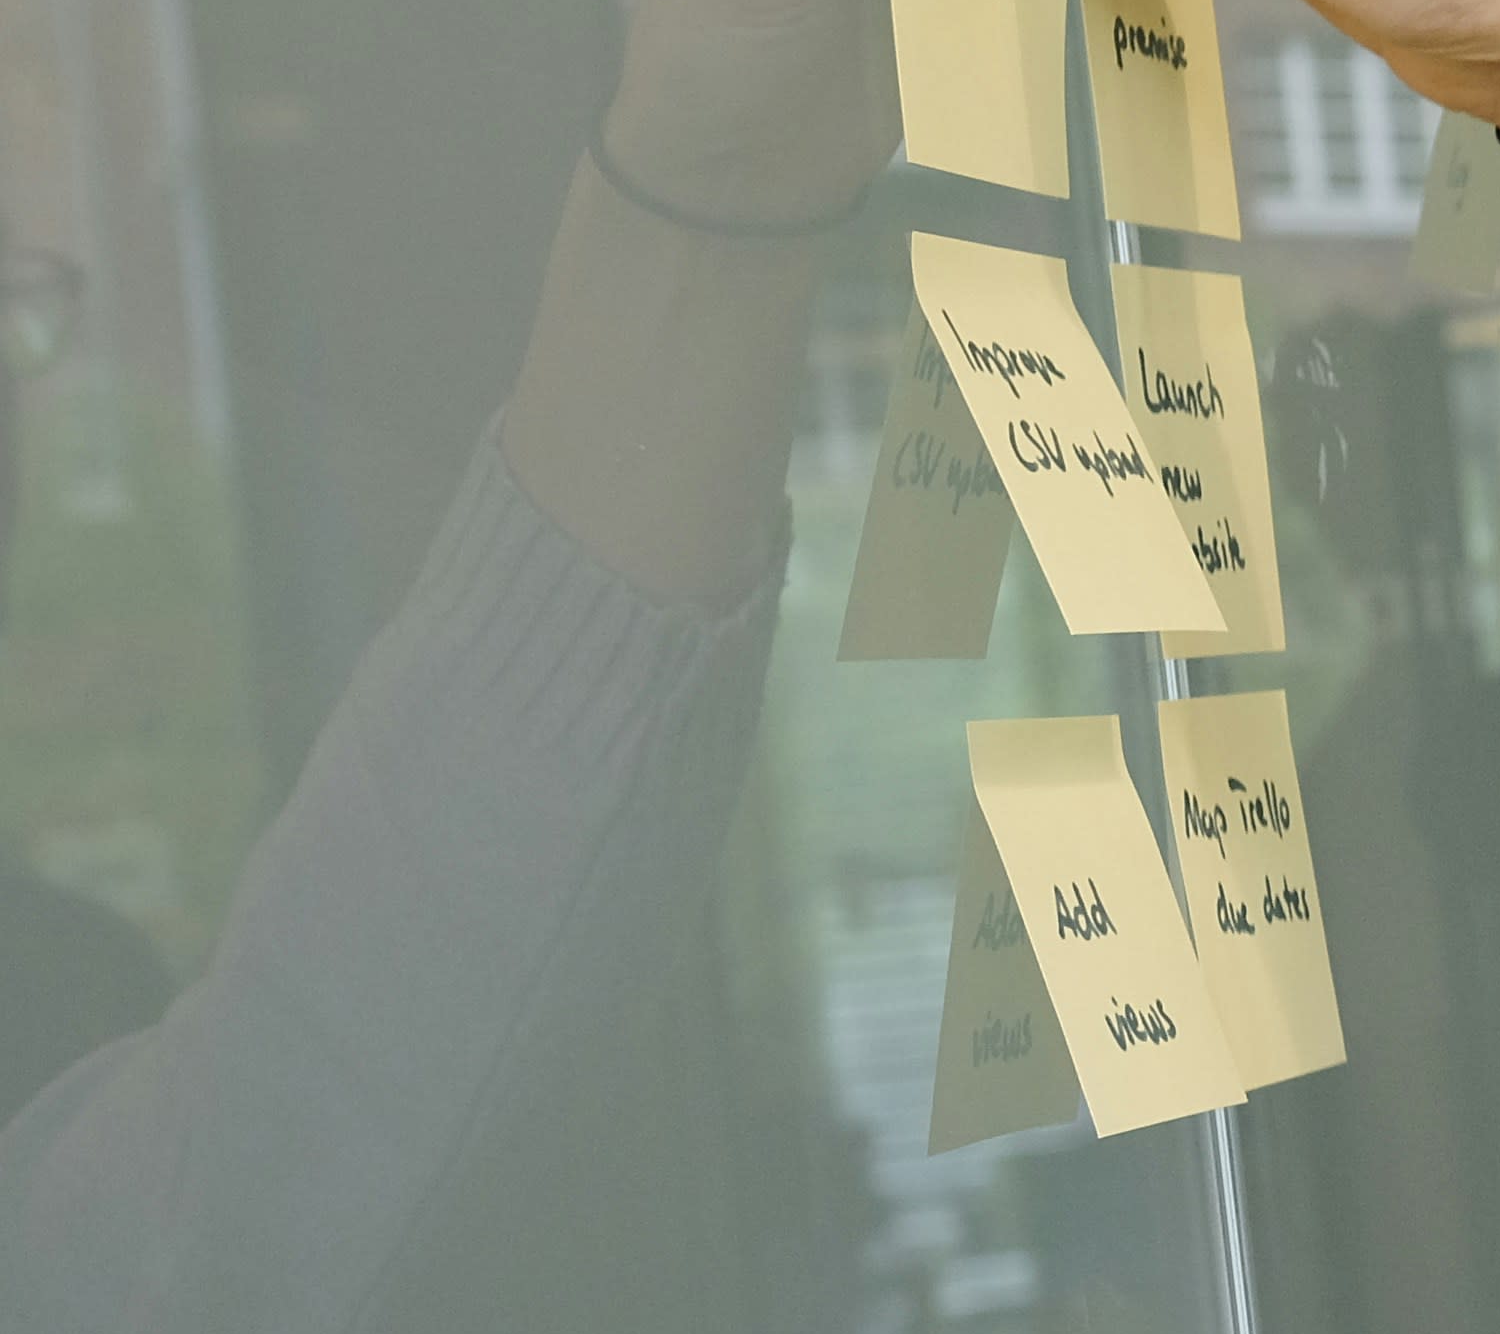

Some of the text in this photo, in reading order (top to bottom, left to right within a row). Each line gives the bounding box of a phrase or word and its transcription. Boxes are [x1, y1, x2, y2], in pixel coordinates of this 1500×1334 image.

[942, 309, 1066, 399] Improve
[1138, 347, 1225, 419] Launch
[1008, 420, 1154, 497] CSV upload
[1161, 465, 1202, 502] new
[1183, 776, 1290, 860] Map Trello
[1053, 877, 1118, 941] Add
[1216, 874, 1311, 935] due dates
[1104, 995, 1177, 1052] views
